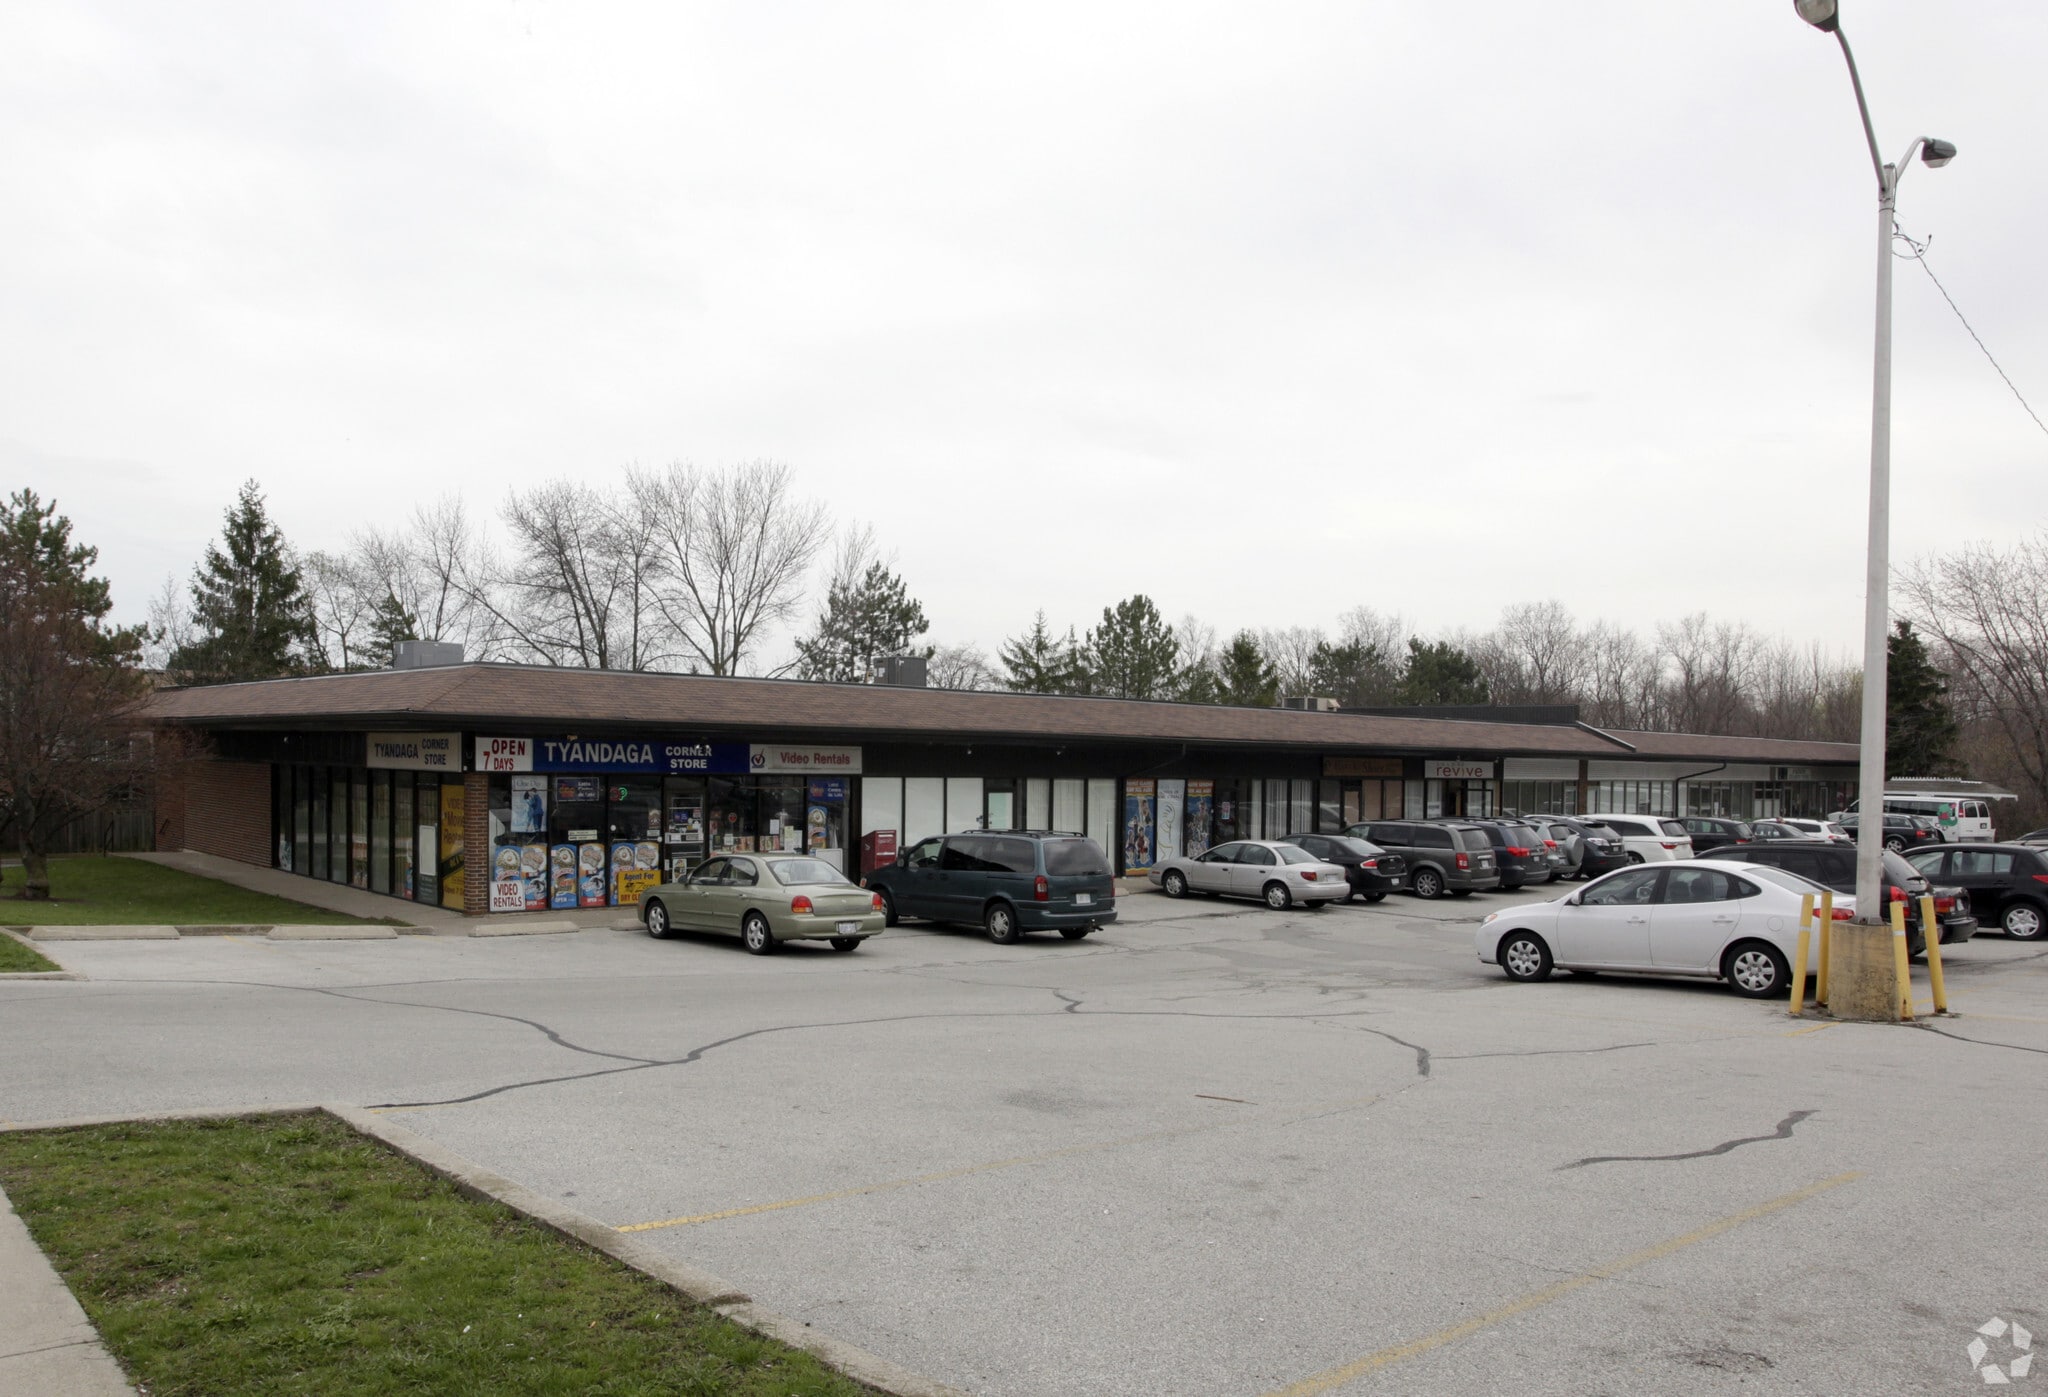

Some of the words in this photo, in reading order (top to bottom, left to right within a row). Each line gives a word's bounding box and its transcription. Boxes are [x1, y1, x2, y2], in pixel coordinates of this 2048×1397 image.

[422, 738, 449, 750] CORNER
[492, 739, 525, 755] OPEN
[375, 743, 419, 759] TYANDAGA
[544, 742, 654, 763] TYANDAGA
[665, 745, 712, 757] CORNER
[425, 754, 447, 765] STORE
[483, 751, 490, 769] 7
[494, 758, 514, 770] DAYS
[670, 758, 708, 769] STORE
[780, 752, 809, 764] Video
[813, 753, 851, 765] Rentals
[1436, 766, 1483, 777] revive
[497, 883, 517, 896] VIDEO
[493, 897, 522, 908] RENTALS
